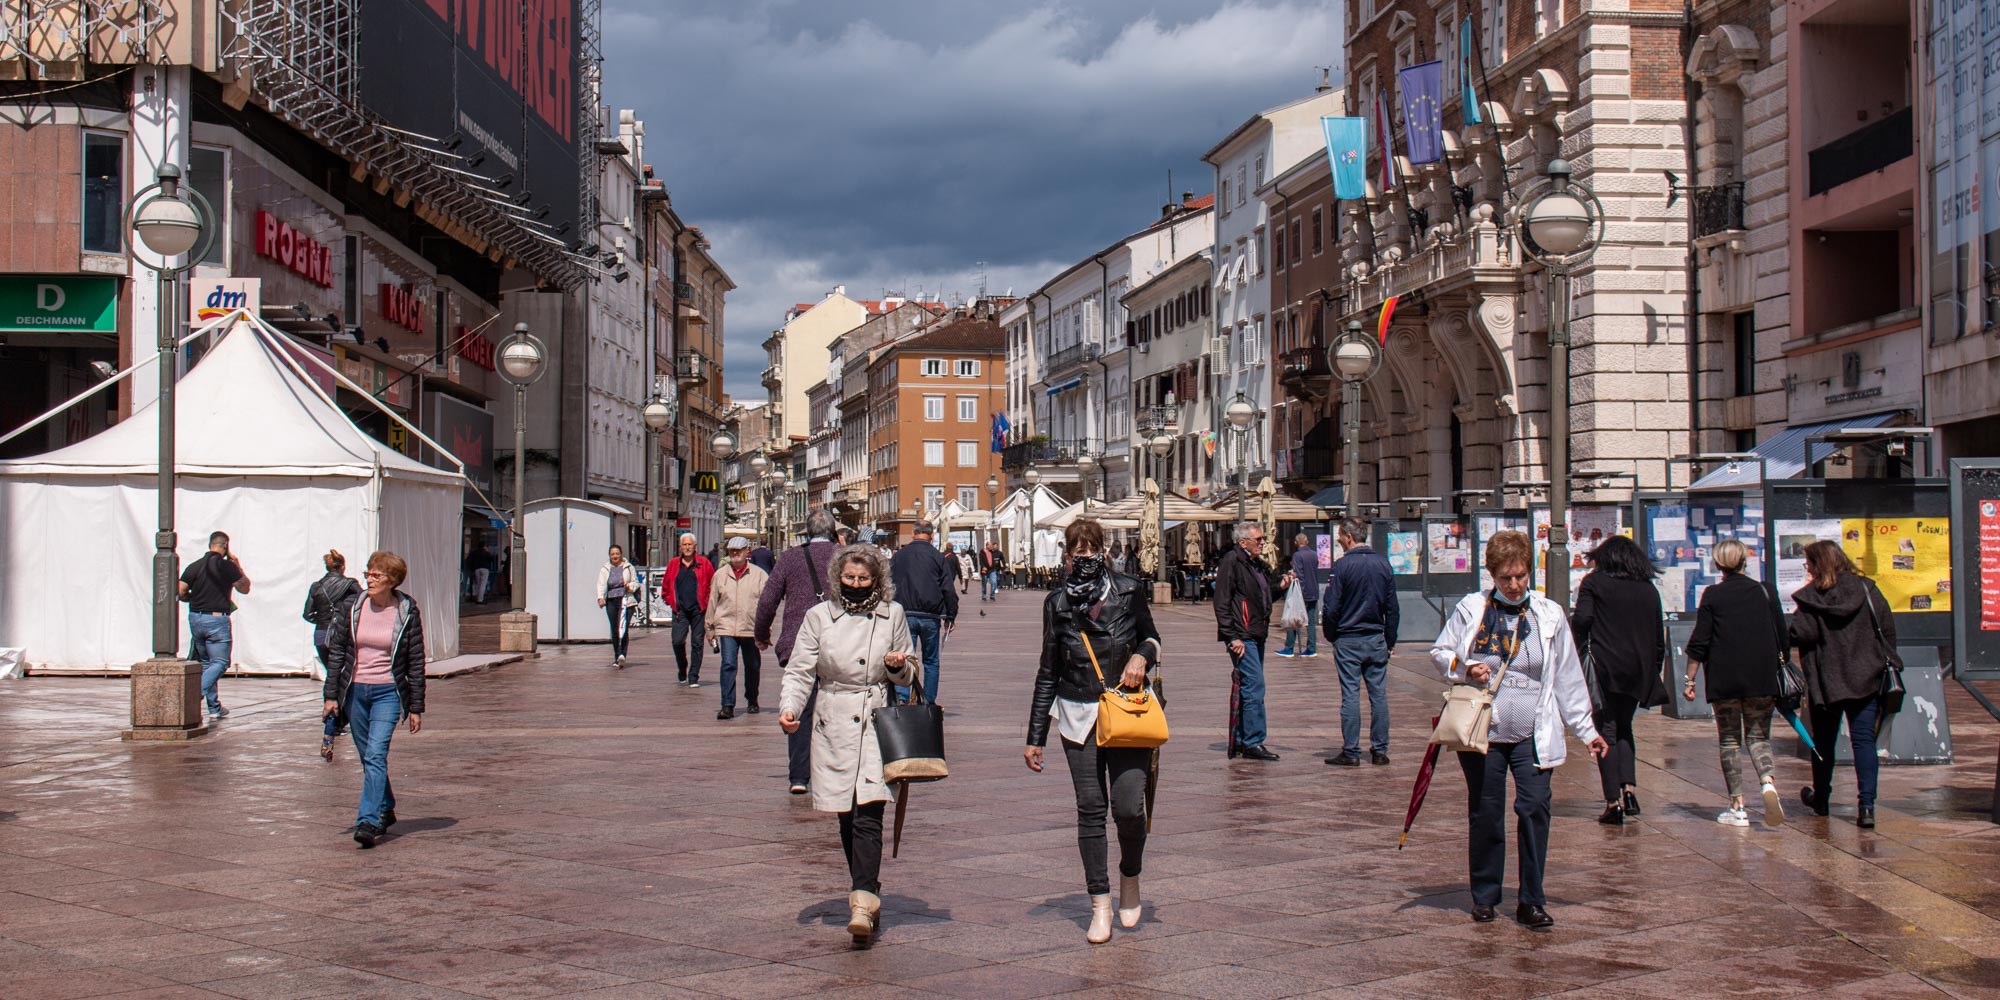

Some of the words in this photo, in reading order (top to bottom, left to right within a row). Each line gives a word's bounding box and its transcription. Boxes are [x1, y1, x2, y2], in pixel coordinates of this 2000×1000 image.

[1941, 22, 1975, 65] Dners
[258, 210, 333, 288] ROBNA
[37, 284, 65, 311] D
[206, 285, 247, 308] dm
[16, 316, 86, 325] DEICHMANN
[1865, 521, 1898, 537] STOP
